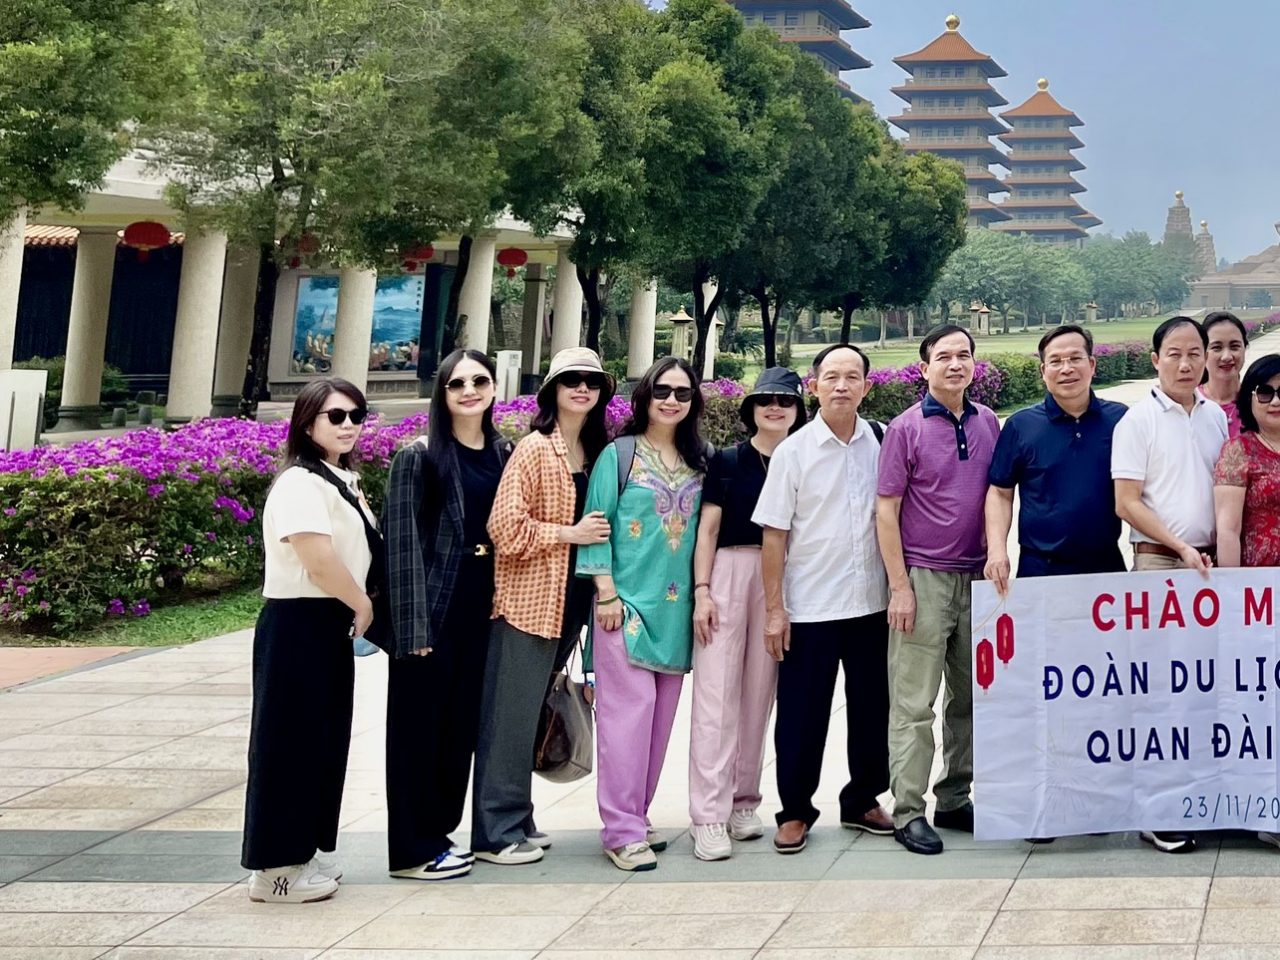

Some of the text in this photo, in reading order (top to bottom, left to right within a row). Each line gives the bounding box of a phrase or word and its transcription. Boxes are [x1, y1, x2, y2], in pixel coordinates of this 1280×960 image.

[1091, 578, 1220, 632] CHÀO
[1042, 651, 1149, 701] ĐOÀN
[1170, 658, 1215, 694] DU
[1086, 726, 1190, 765] QUAN
[1210, 713, 1273, 760] ĐÀI
